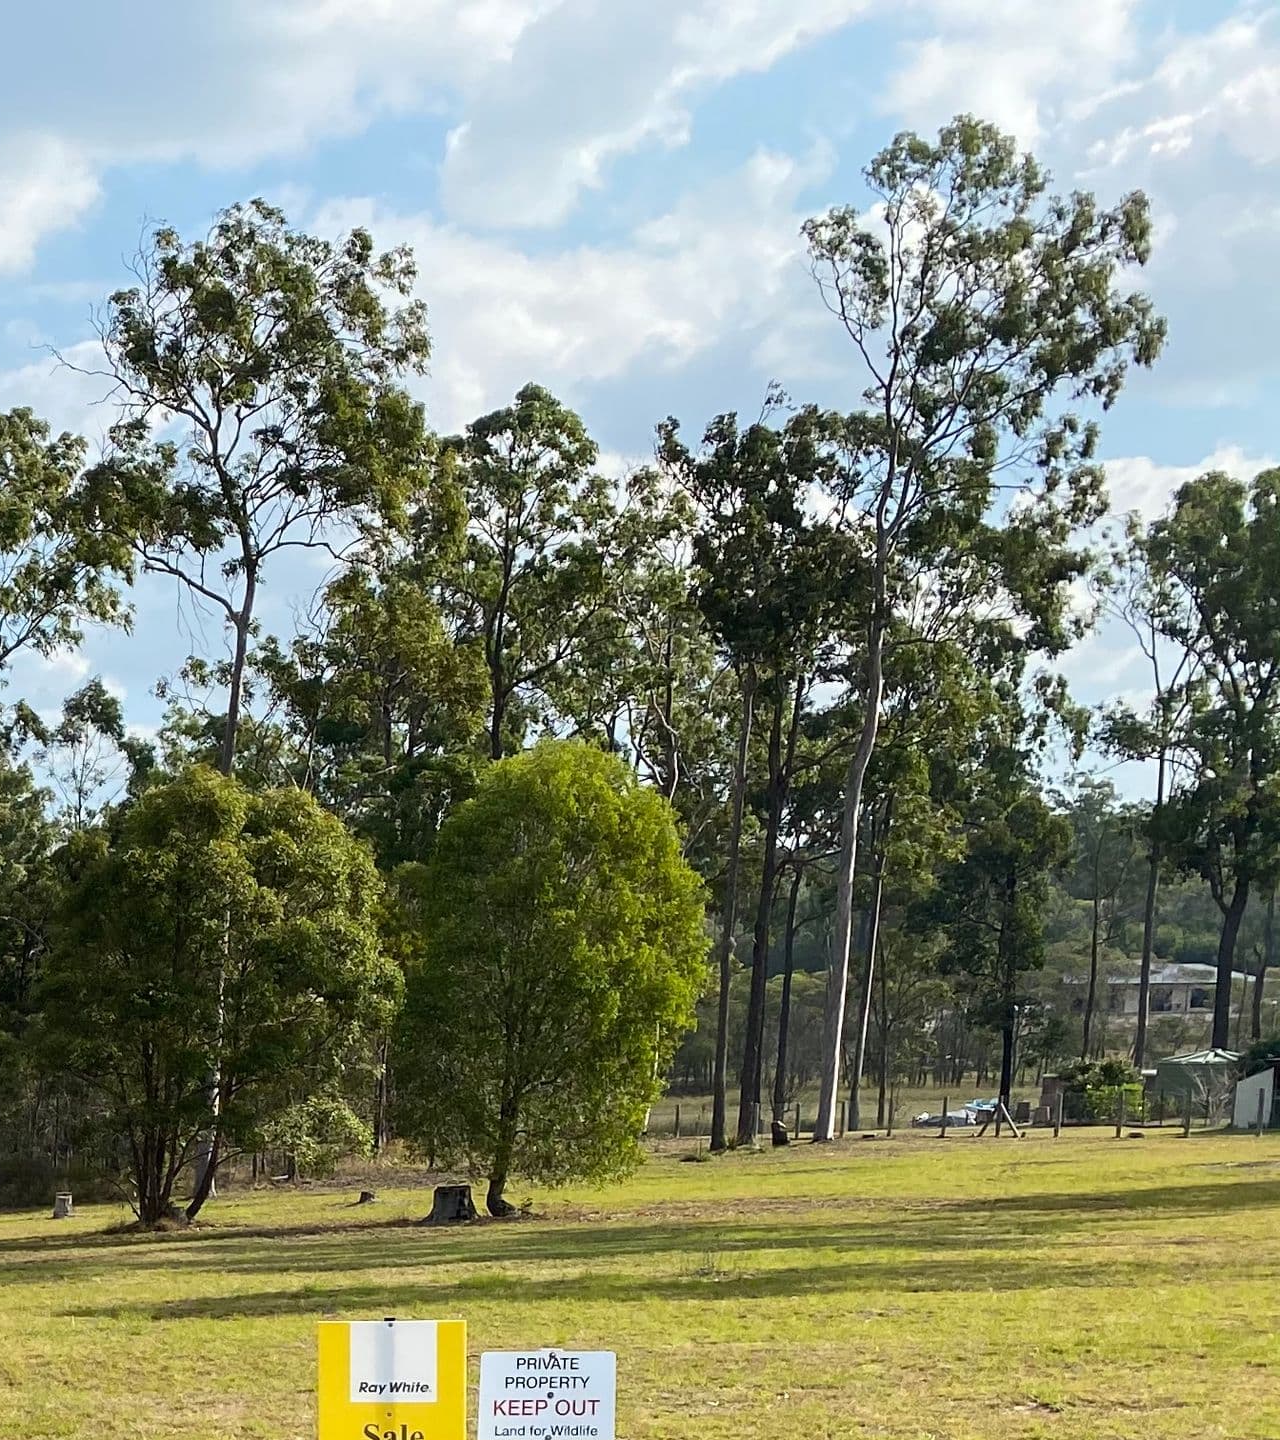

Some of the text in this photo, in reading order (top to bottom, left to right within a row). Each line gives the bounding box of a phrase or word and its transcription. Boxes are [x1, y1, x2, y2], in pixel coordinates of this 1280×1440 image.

[516, 1357, 580, 1370] PRIVATE
[359, 1381, 430, 1395] Ray White
[505, 1376, 591, 1389] PROPERTY
[493, 1399, 601, 1416] KEEP OUT
[494, 1425, 598, 1437] Land for Wildlife
